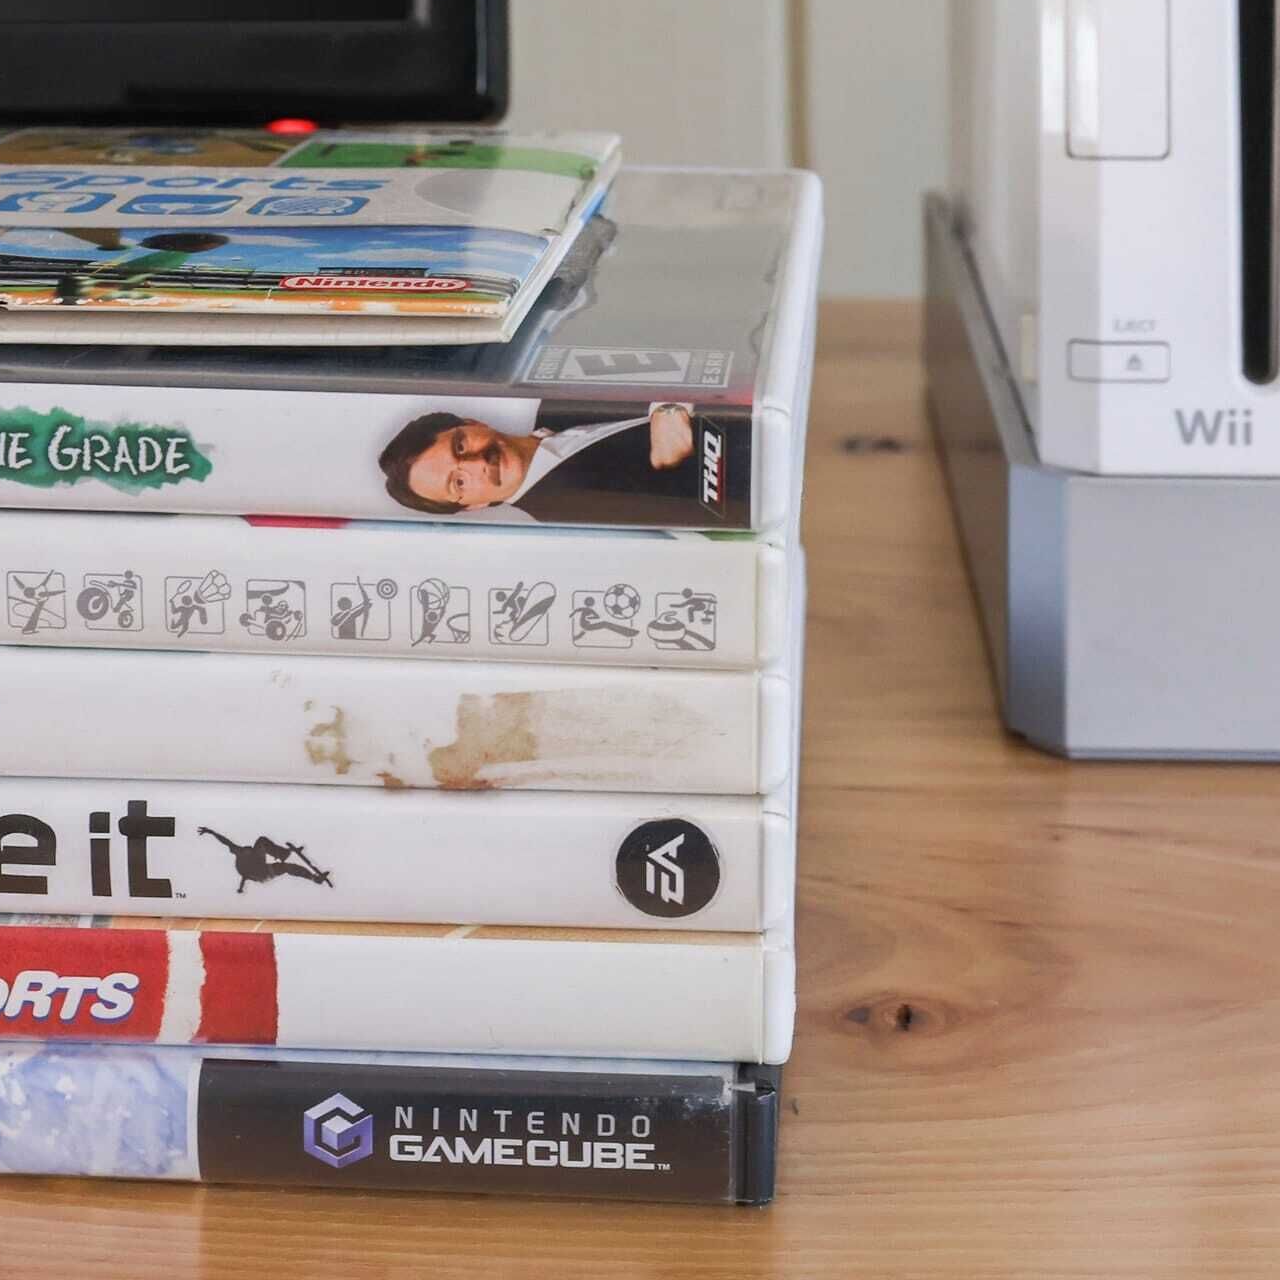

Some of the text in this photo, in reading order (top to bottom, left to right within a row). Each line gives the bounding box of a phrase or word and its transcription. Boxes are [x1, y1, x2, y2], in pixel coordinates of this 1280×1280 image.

[295, 277, 457, 289] Nintendo
[47, 425, 192, 475] GRADE
[1175, 409, 1254, 447] Wii
[703, 430, 723, 504] THQ
[88, 799, 176, 898] it
[646, 833, 685, 905] EA
[394, 1105, 652, 1138] NINTENDO
[389, 1134, 657, 1172] GAMECUBE
